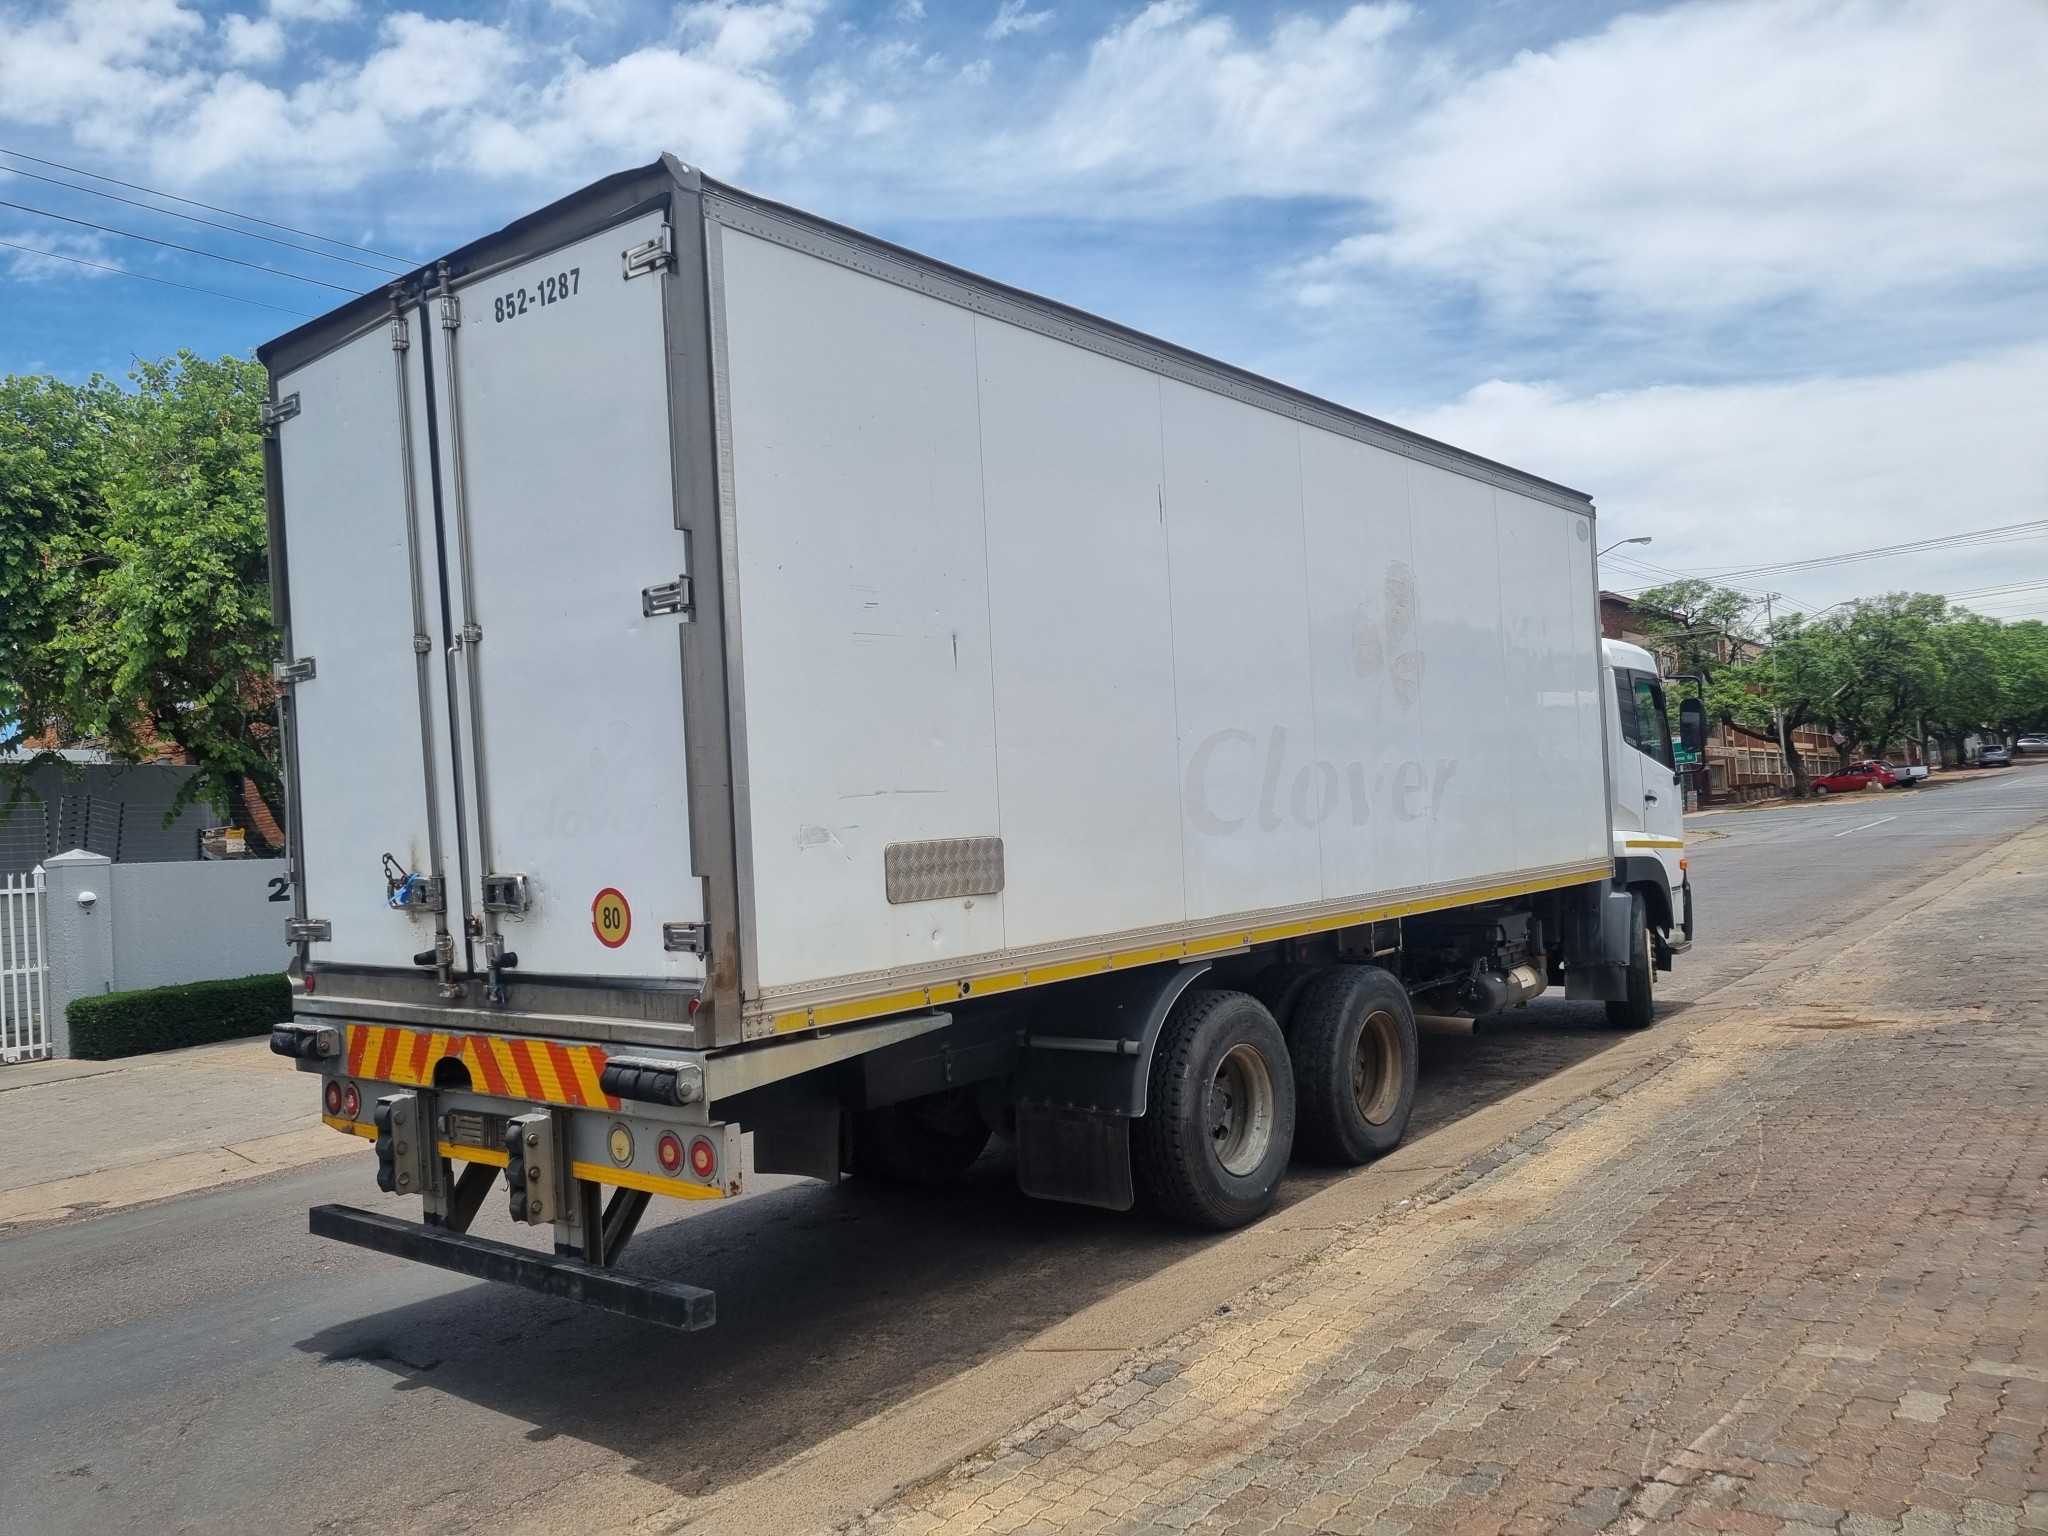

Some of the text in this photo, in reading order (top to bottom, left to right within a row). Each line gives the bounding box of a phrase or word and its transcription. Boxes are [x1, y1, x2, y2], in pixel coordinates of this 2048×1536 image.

[494, 267, 580, 324] 852-1287
[1184, 725, 1459, 837] Clover
[267, 877, 291, 903] 2
[603, 906, 621, 929] 80
